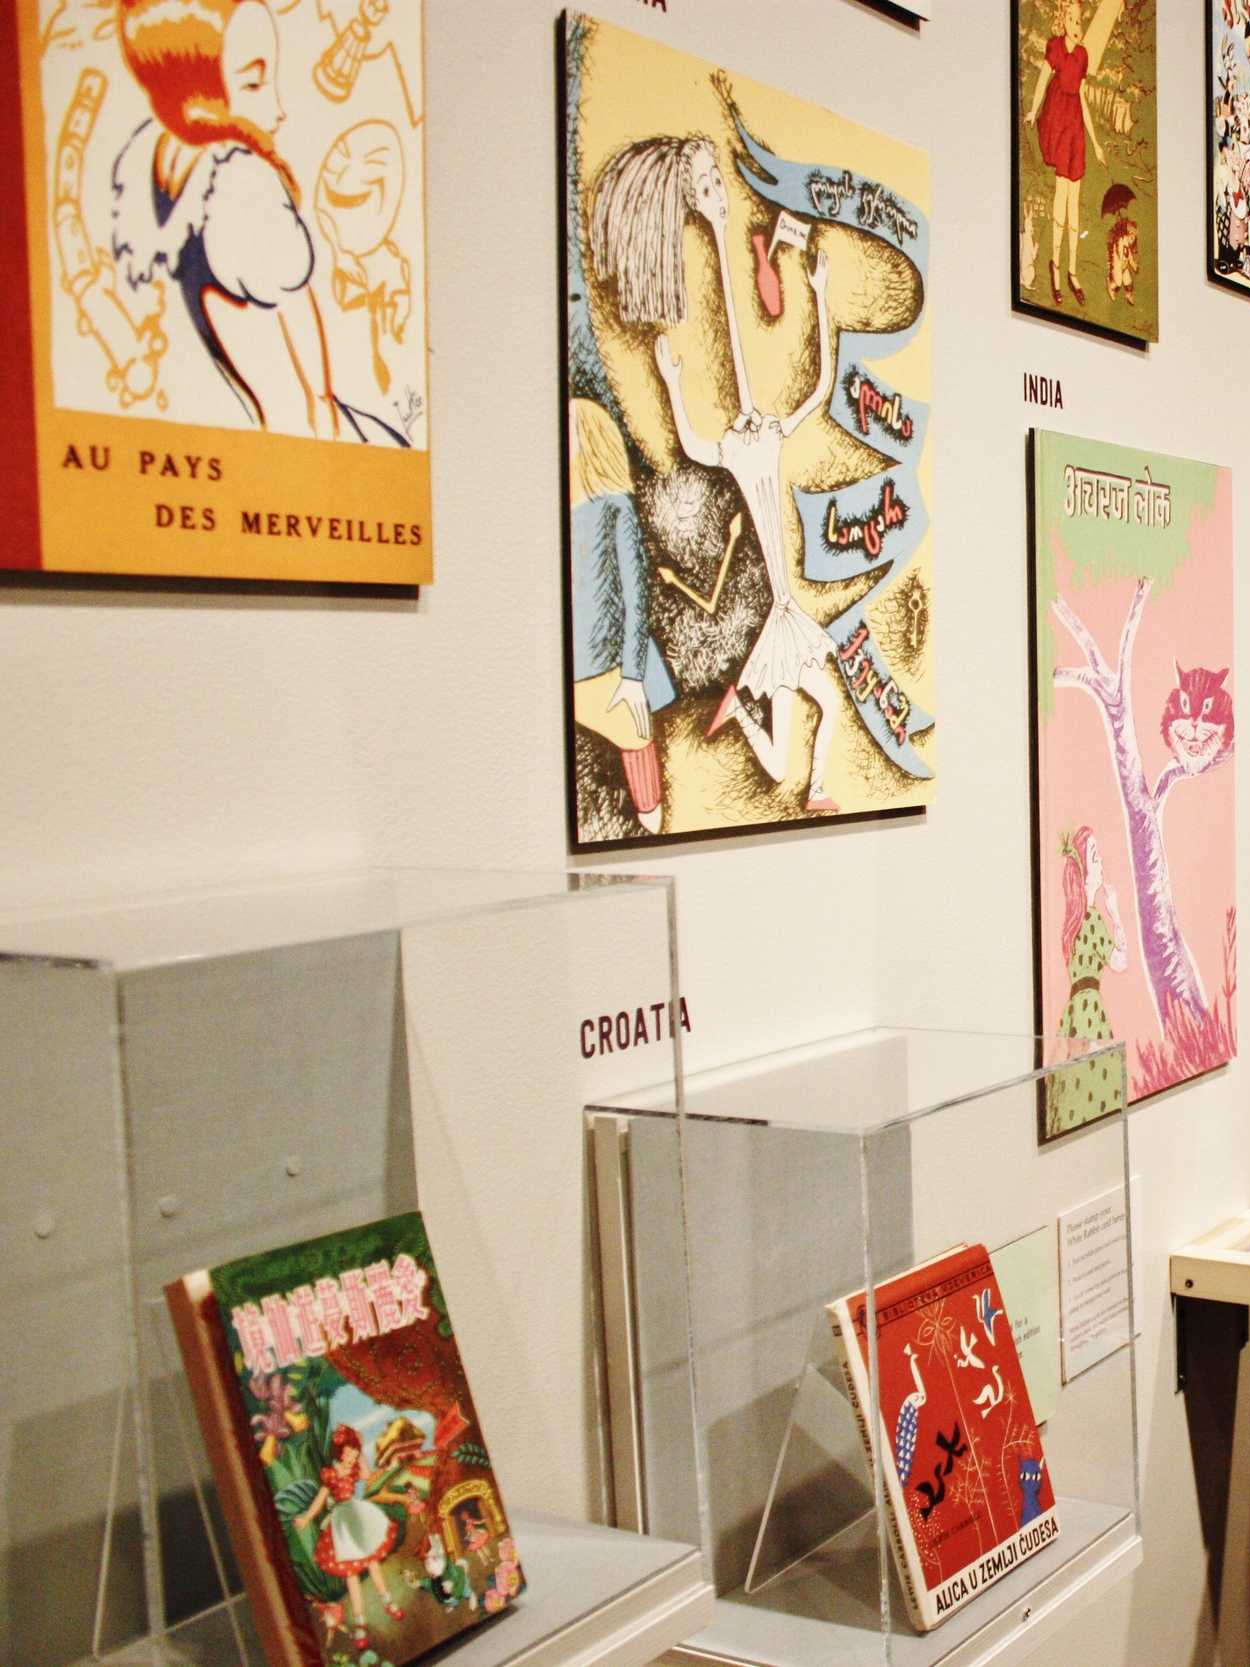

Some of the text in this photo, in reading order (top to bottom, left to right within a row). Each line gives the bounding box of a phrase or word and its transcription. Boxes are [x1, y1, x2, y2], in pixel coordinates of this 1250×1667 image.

[1024, 373, 1063, 409] INDIA
[62, 443, 224, 481] AU PAYS
[1133, 464, 1172, 529] लोक
[155, 504, 423, 547] DES MERVEILLES
[580, 996, 691, 1059] CROATIA
[935, 1516, 1060, 1615] ALICA U ZEMLJI ČUDESA
